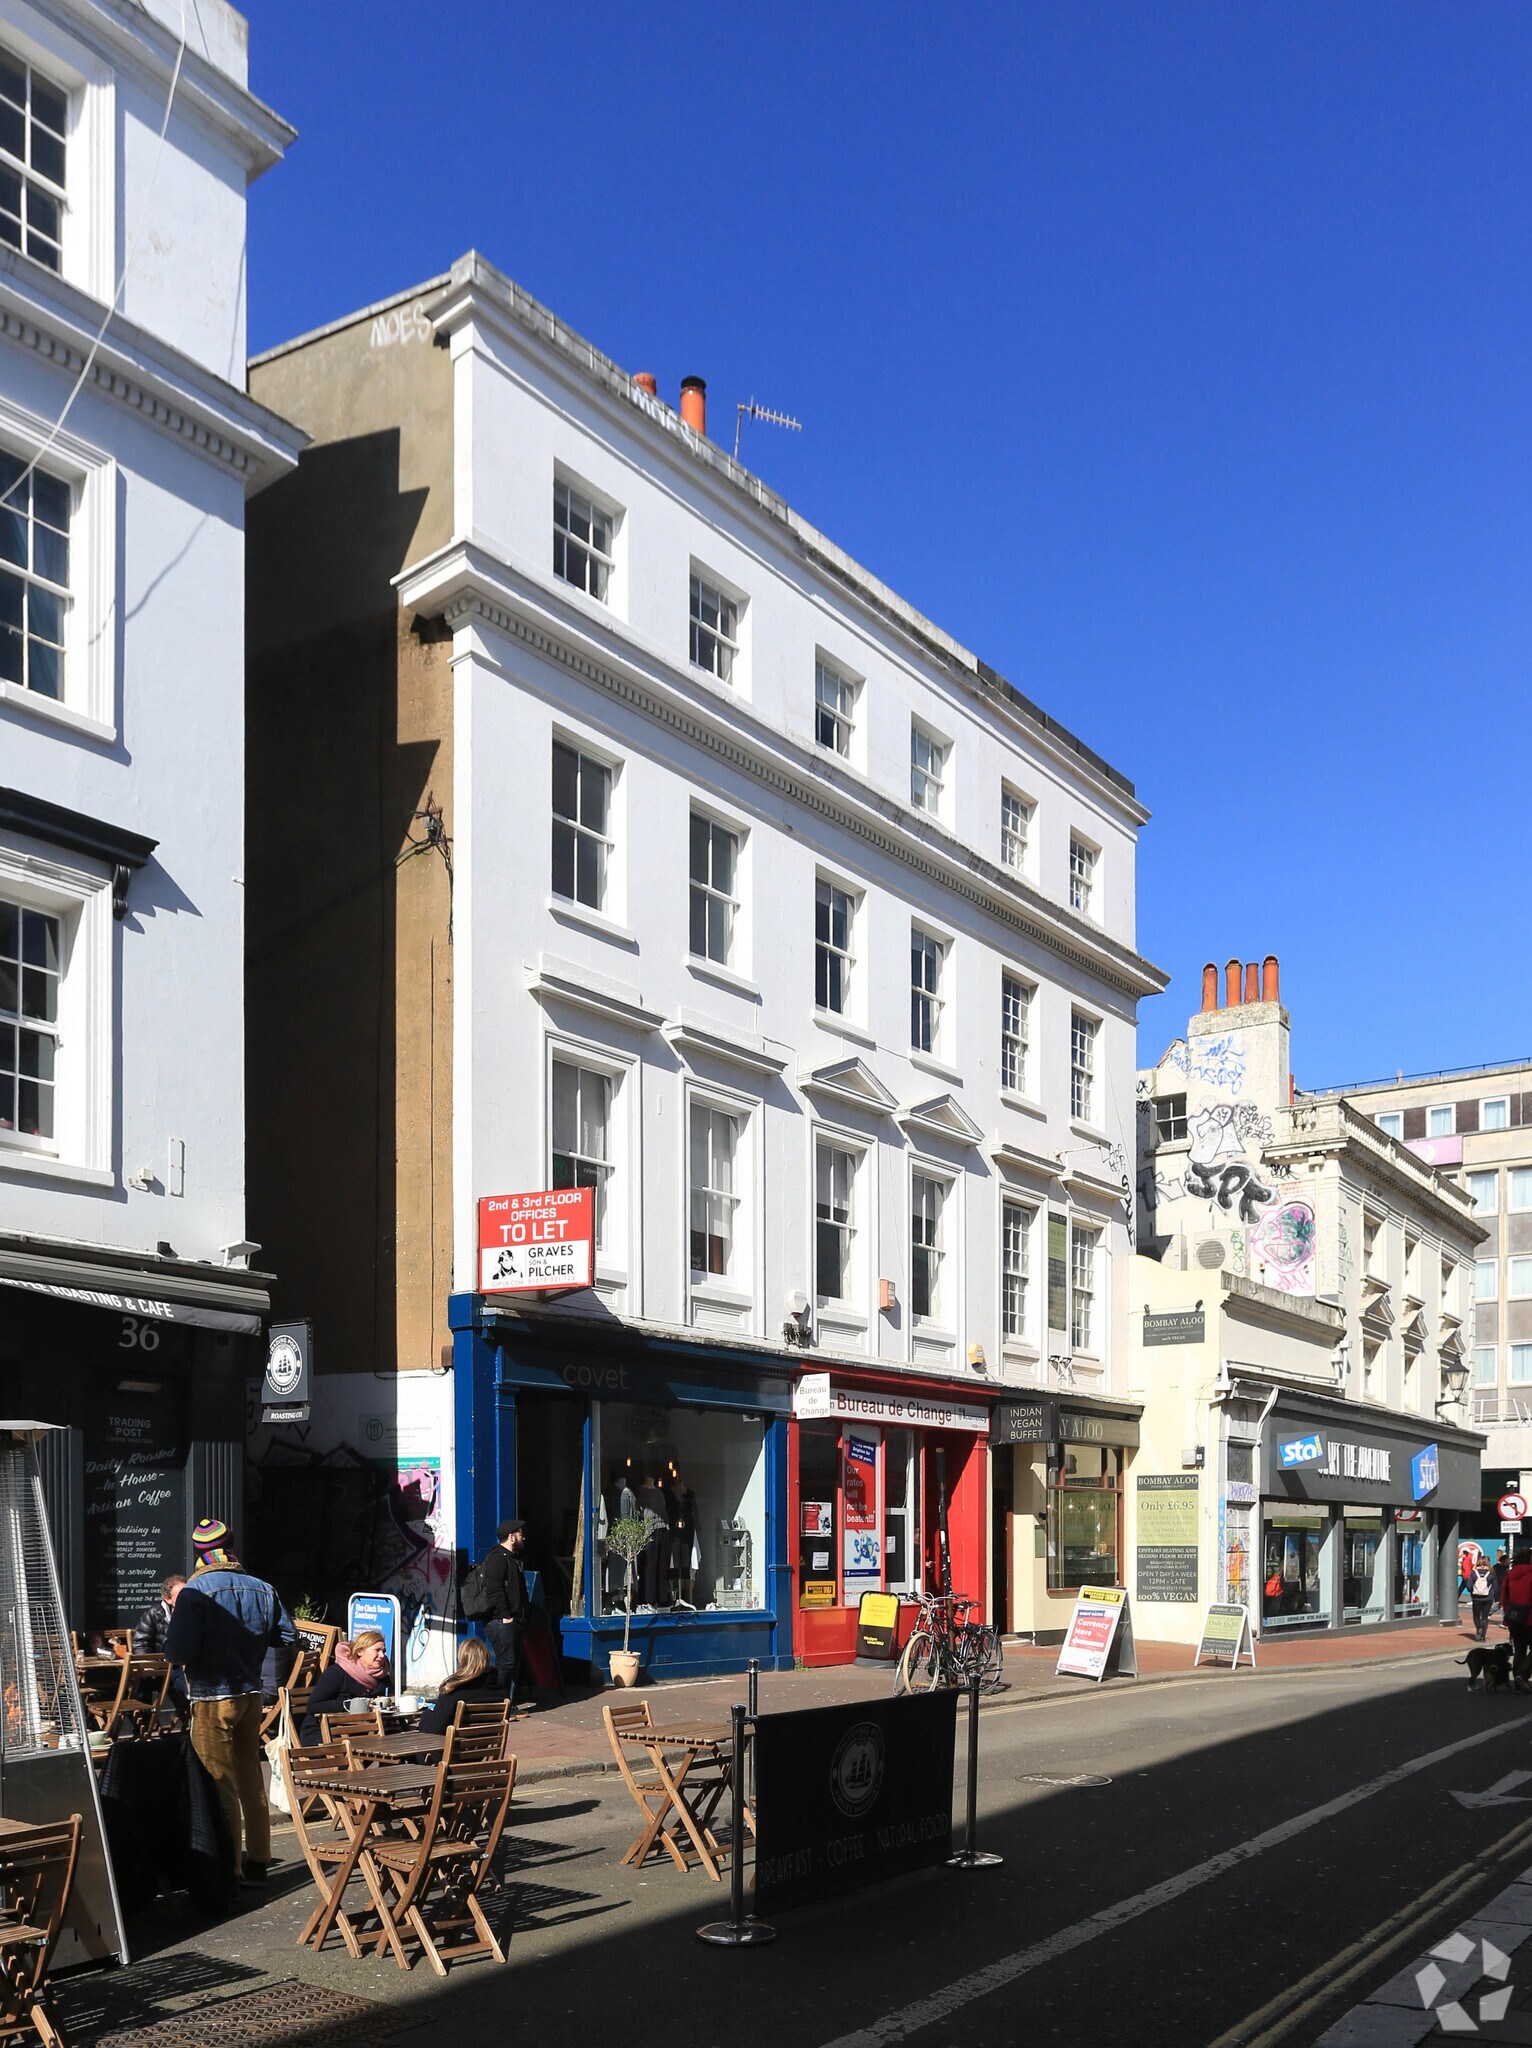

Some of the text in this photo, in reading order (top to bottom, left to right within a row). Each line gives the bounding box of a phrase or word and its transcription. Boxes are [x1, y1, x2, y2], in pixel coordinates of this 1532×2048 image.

[488, 1192, 582, 1211] 2nd & 3rd FLOOR
[511, 1207, 557, 1222] OFFICES
[500, 1219, 569, 1243] TO LET
[528, 1244, 574, 1259] GRAVES
[528, 1264, 574, 1278] PILCHER
[50, 1284, 123, 1308] ROASTING
[124, 1297, 138, 1312] &
[138, 1298, 175, 1318] CAFE
[1144, 1316, 1204, 1328] BOMBAY ALOO
[118, 1317, 160, 1351] 36
[288, 1338, 299, 1352] POST
[563, 1364, 629, 1390] covet
[800, 1386, 827, 1395] Bureau
[808, 1396, 818, 1404] de
[800, 1408, 829, 1416] Change
[837, 1392, 884, 1415] Bureau
[888, 1399, 903, 1417] de
[907, 1401, 952, 1425] Change
[1010, 1407, 1042, 1417] INDIAN
[108, 1416, 151, 1428] TRADING
[1010, 1418, 1042, 1428] VEGAN
[115, 1426, 143, 1437] POST
[1010, 1429, 1043, 1440] BUFFET
[1071, 1420, 1104, 1440] ALOO
[1284, 1440, 1319, 1463] sta
[85, 1447, 176, 1474] Daily Roasted
[847, 1466, 860, 1474] Our
[847, 1479, 864, 1487] rates
[1173, 1476, 1198, 1484] ALOO
[846, 1490, 858, 1499] will
[87, 1490, 171, 1515] Artisan Coffee
[846, 1502, 868, 1511] not be
[1141, 1501, 1194, 1513] Only £6.95
[151, 1526, 161, 1534] in
[127, 1567, 157, 1578] serving
[1138, 1592, 1197, 1601] 100% VEGAN
[377, 1605, 391, 1613] Tower
[1077, 1618, 1110, 1630] Currency
[299, 1631, 326, 1644] TRADING
[1074, 1628, 1092, 1637] Here
[760, 1847, 812, 1888] BREAKFAST
[826, 1834, 865, 1866] COFFEE
[877, 1821, 917, 1851] NATURAL
[920, 1812, 949, 1839] FOOD
